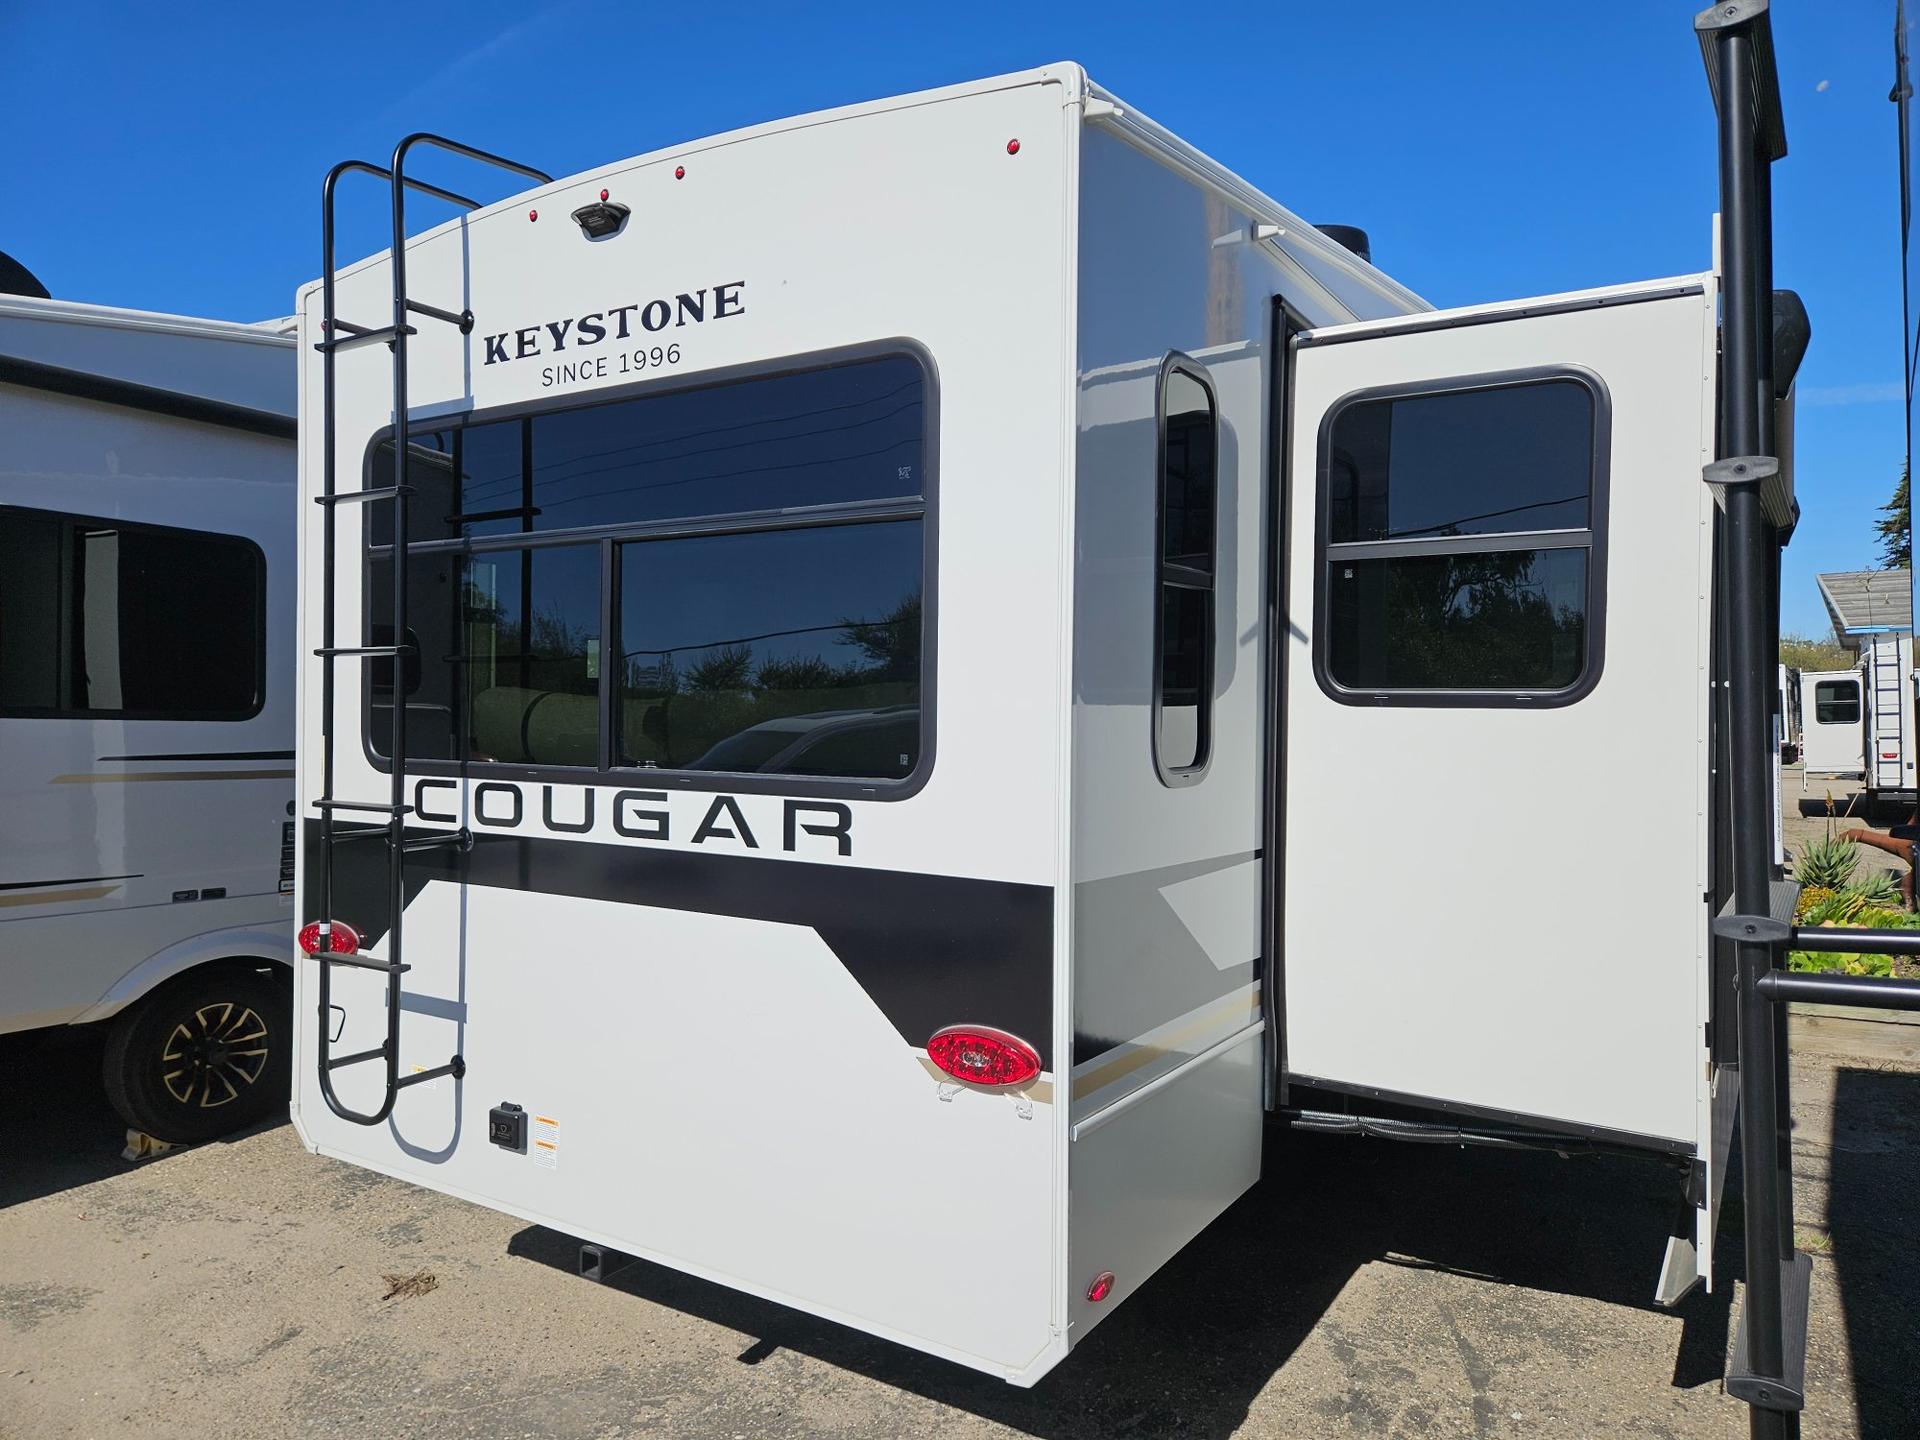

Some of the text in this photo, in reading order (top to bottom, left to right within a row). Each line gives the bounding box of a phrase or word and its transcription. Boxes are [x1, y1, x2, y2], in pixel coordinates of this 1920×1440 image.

[484, 280, 745, 365] KEYSTONE
[542, 343, 681, 387] SINCE 1996
[415, 778, 852, 857] COUGAR
